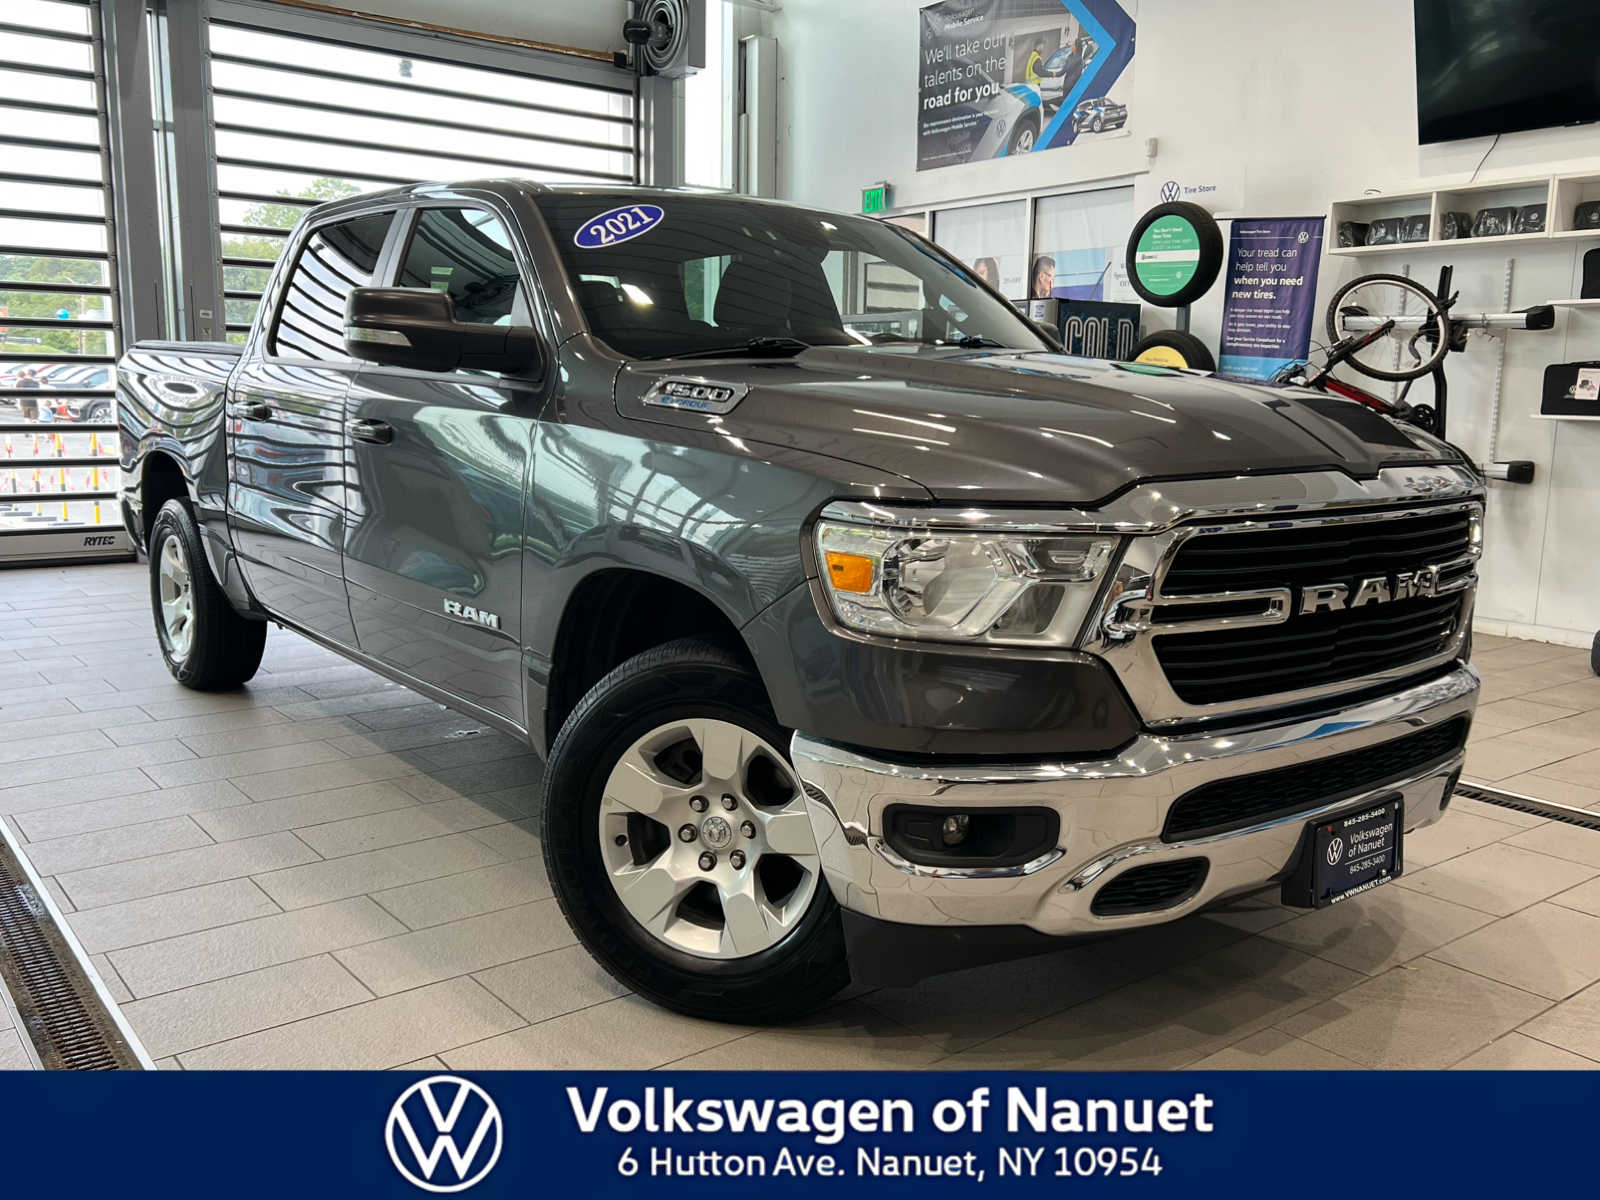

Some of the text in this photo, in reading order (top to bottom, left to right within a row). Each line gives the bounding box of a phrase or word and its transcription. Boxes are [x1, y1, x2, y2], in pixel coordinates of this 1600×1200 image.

[925, 32, 1006, 64] We'll take our
[924, 56, 1007, 88] talents on the
[923, 82, 1000, 110] road for you
[1198, 185, 1216, 193] Store
[864, 190, 884, 212] EXIT
[590, 207, 654, 244] 2021
[1238, 247, 1297, 257] Your tread can
[1235, 262, 1287, 274] help tell you
[1233, 276, 1304, 287] when you need
[1232, 289, 1277, 300] new tires.
[83, 536, 115, 546] RYTEC
[1299, 565, 1437, 615] RAM
[444, 598, 499, 629] RAM
[1350, 823, 1393, 845] Volkswagen
[1348, 837, 1385, 858] of Nanuet
